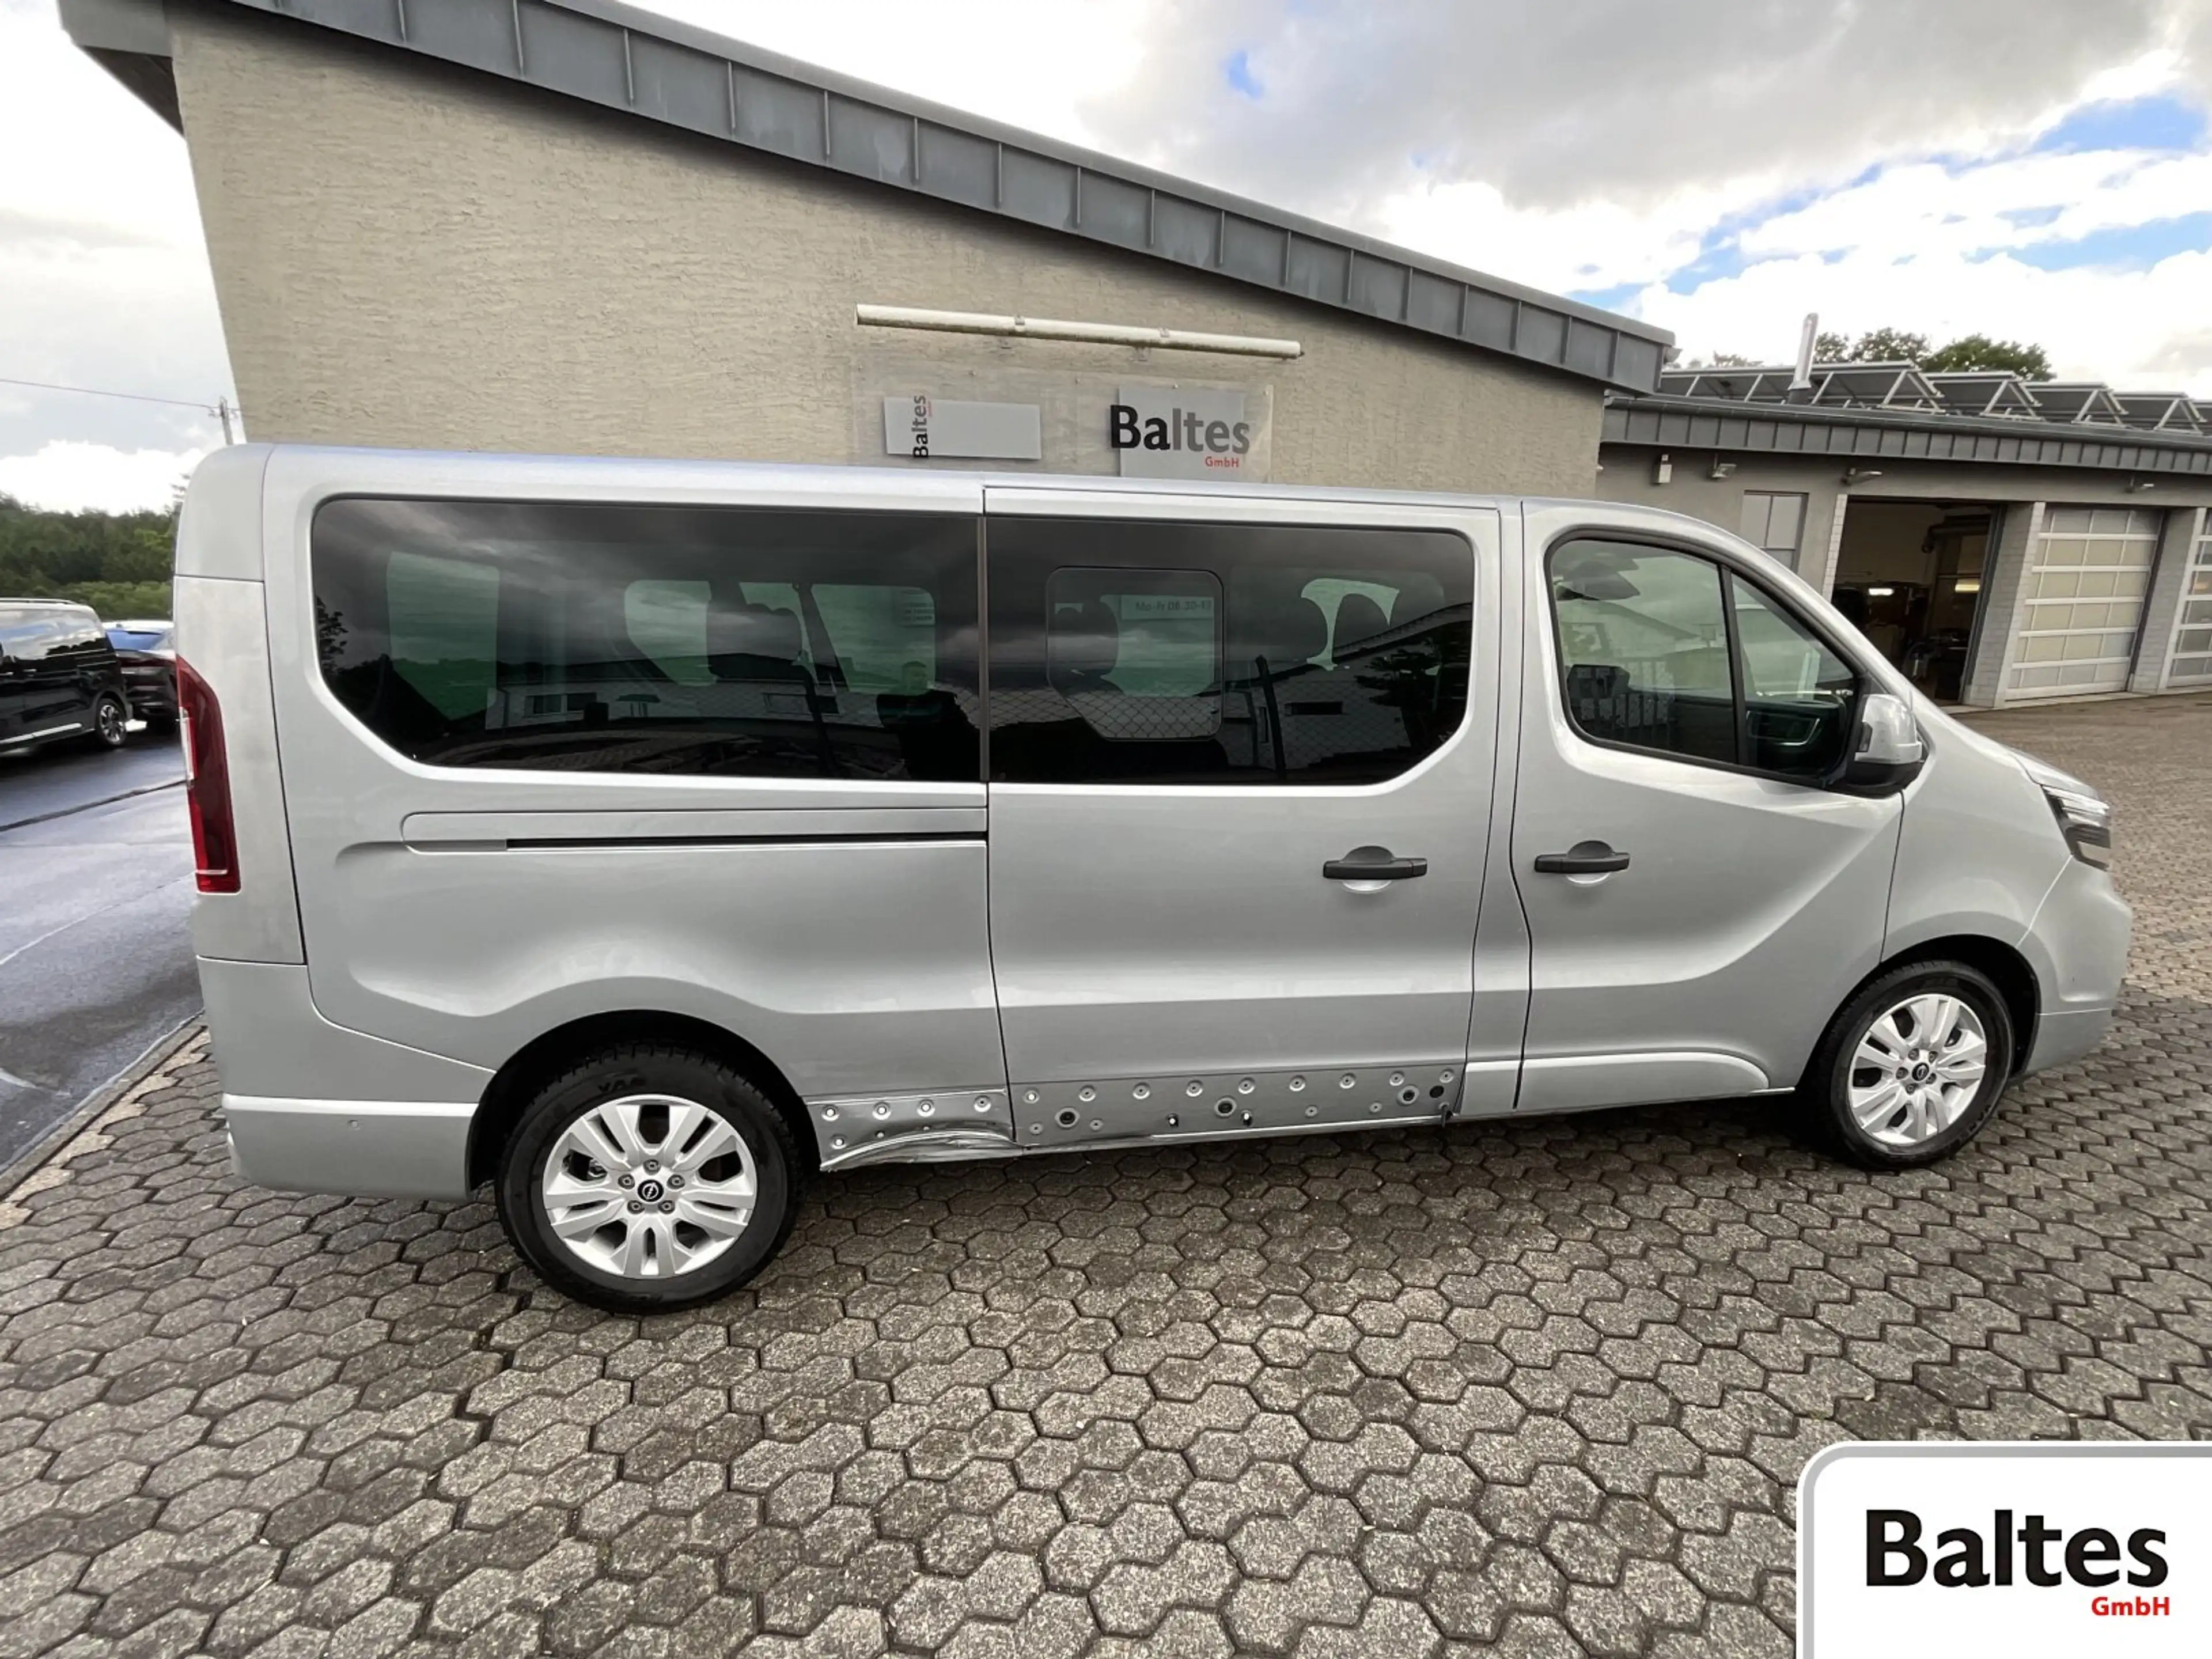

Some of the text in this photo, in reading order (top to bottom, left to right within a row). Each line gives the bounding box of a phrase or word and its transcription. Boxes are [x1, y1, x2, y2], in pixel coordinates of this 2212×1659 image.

[911, 395, 929, 458] Baltes
[1110, 404, 1250, 454] Baltes
[1205, 456, 1240, 468] GmbH
